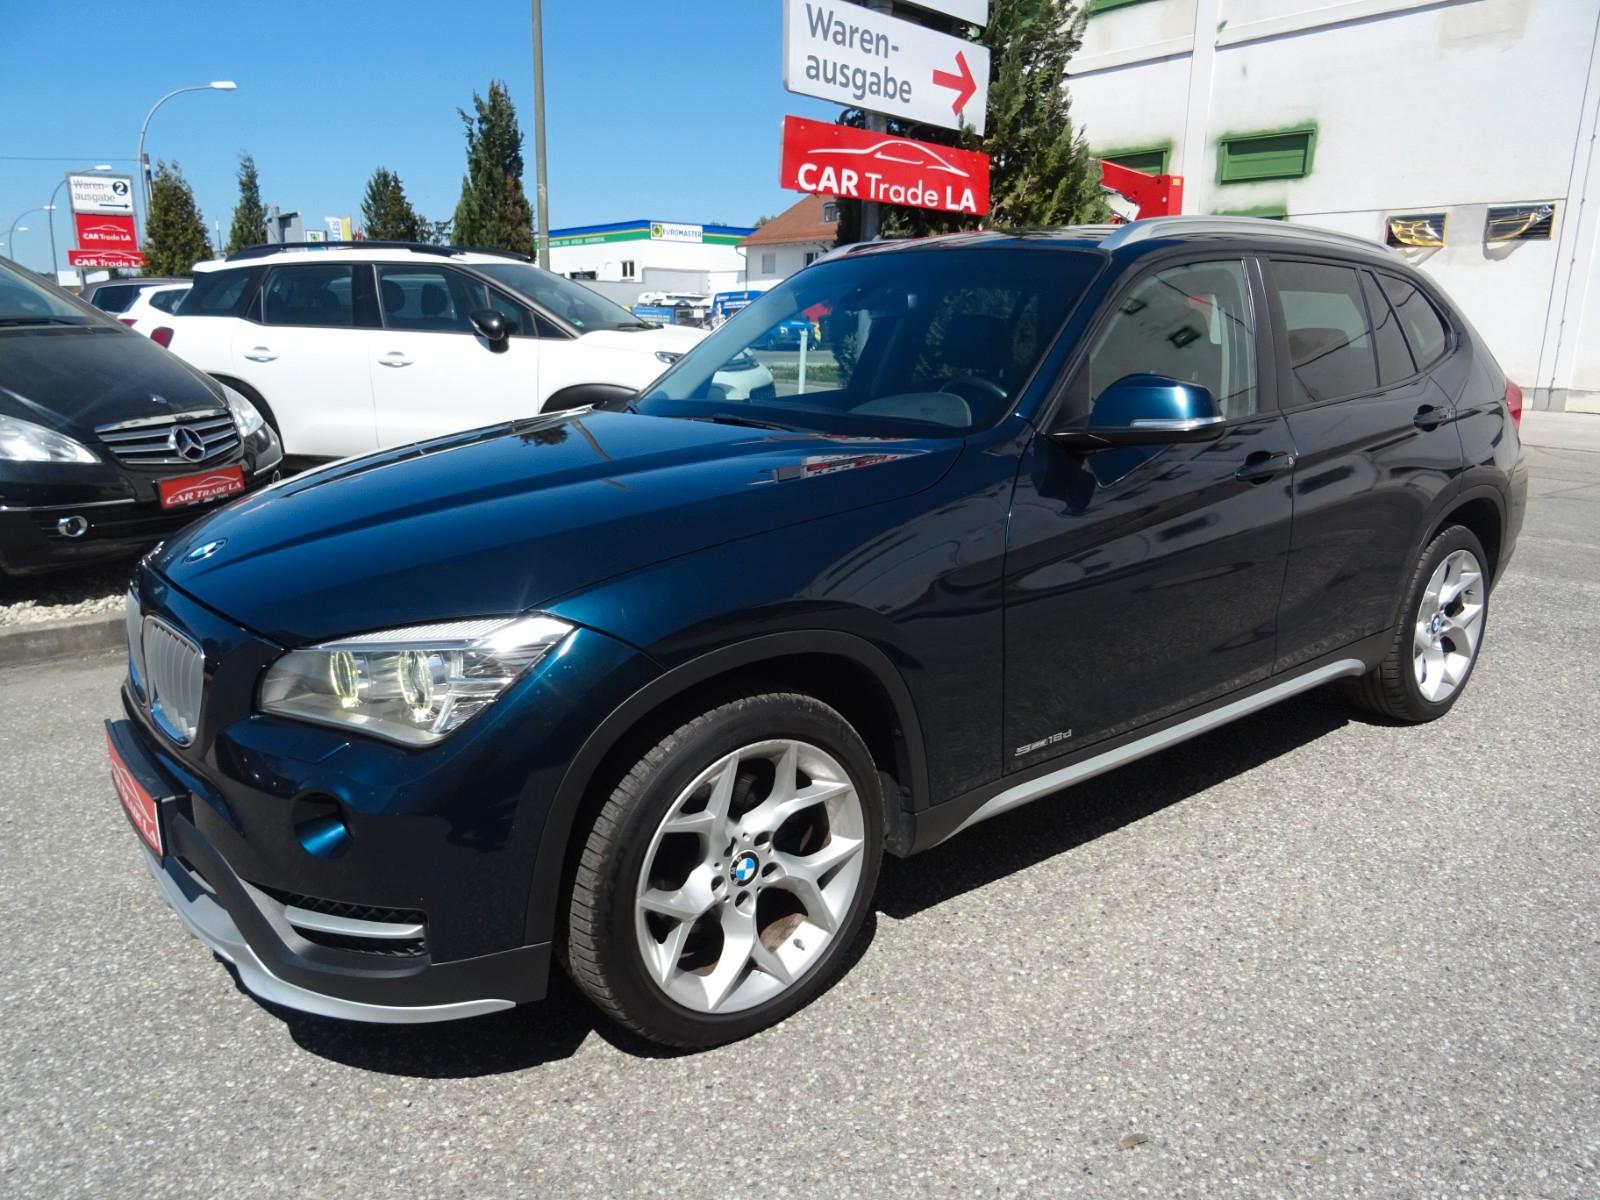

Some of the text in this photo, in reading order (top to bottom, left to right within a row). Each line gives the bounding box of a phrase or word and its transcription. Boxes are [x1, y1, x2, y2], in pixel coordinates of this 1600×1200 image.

[805, 3, 900, 57] Waren-
[804, 52, 913, 104] ausgabe
[797, 162, 977, 213] CAR Trade LA
[75, 192, 116, 203] ausgabe
[100, 233, 120, 241] Trade
[662, 229, 702, 238] EUROMASTER
[74, 258, 97, 266] CAR
[99, 259, 129, 267] Trade
[165, 491, 194, 505] CAR
[228, 480, 242, 491] LA
